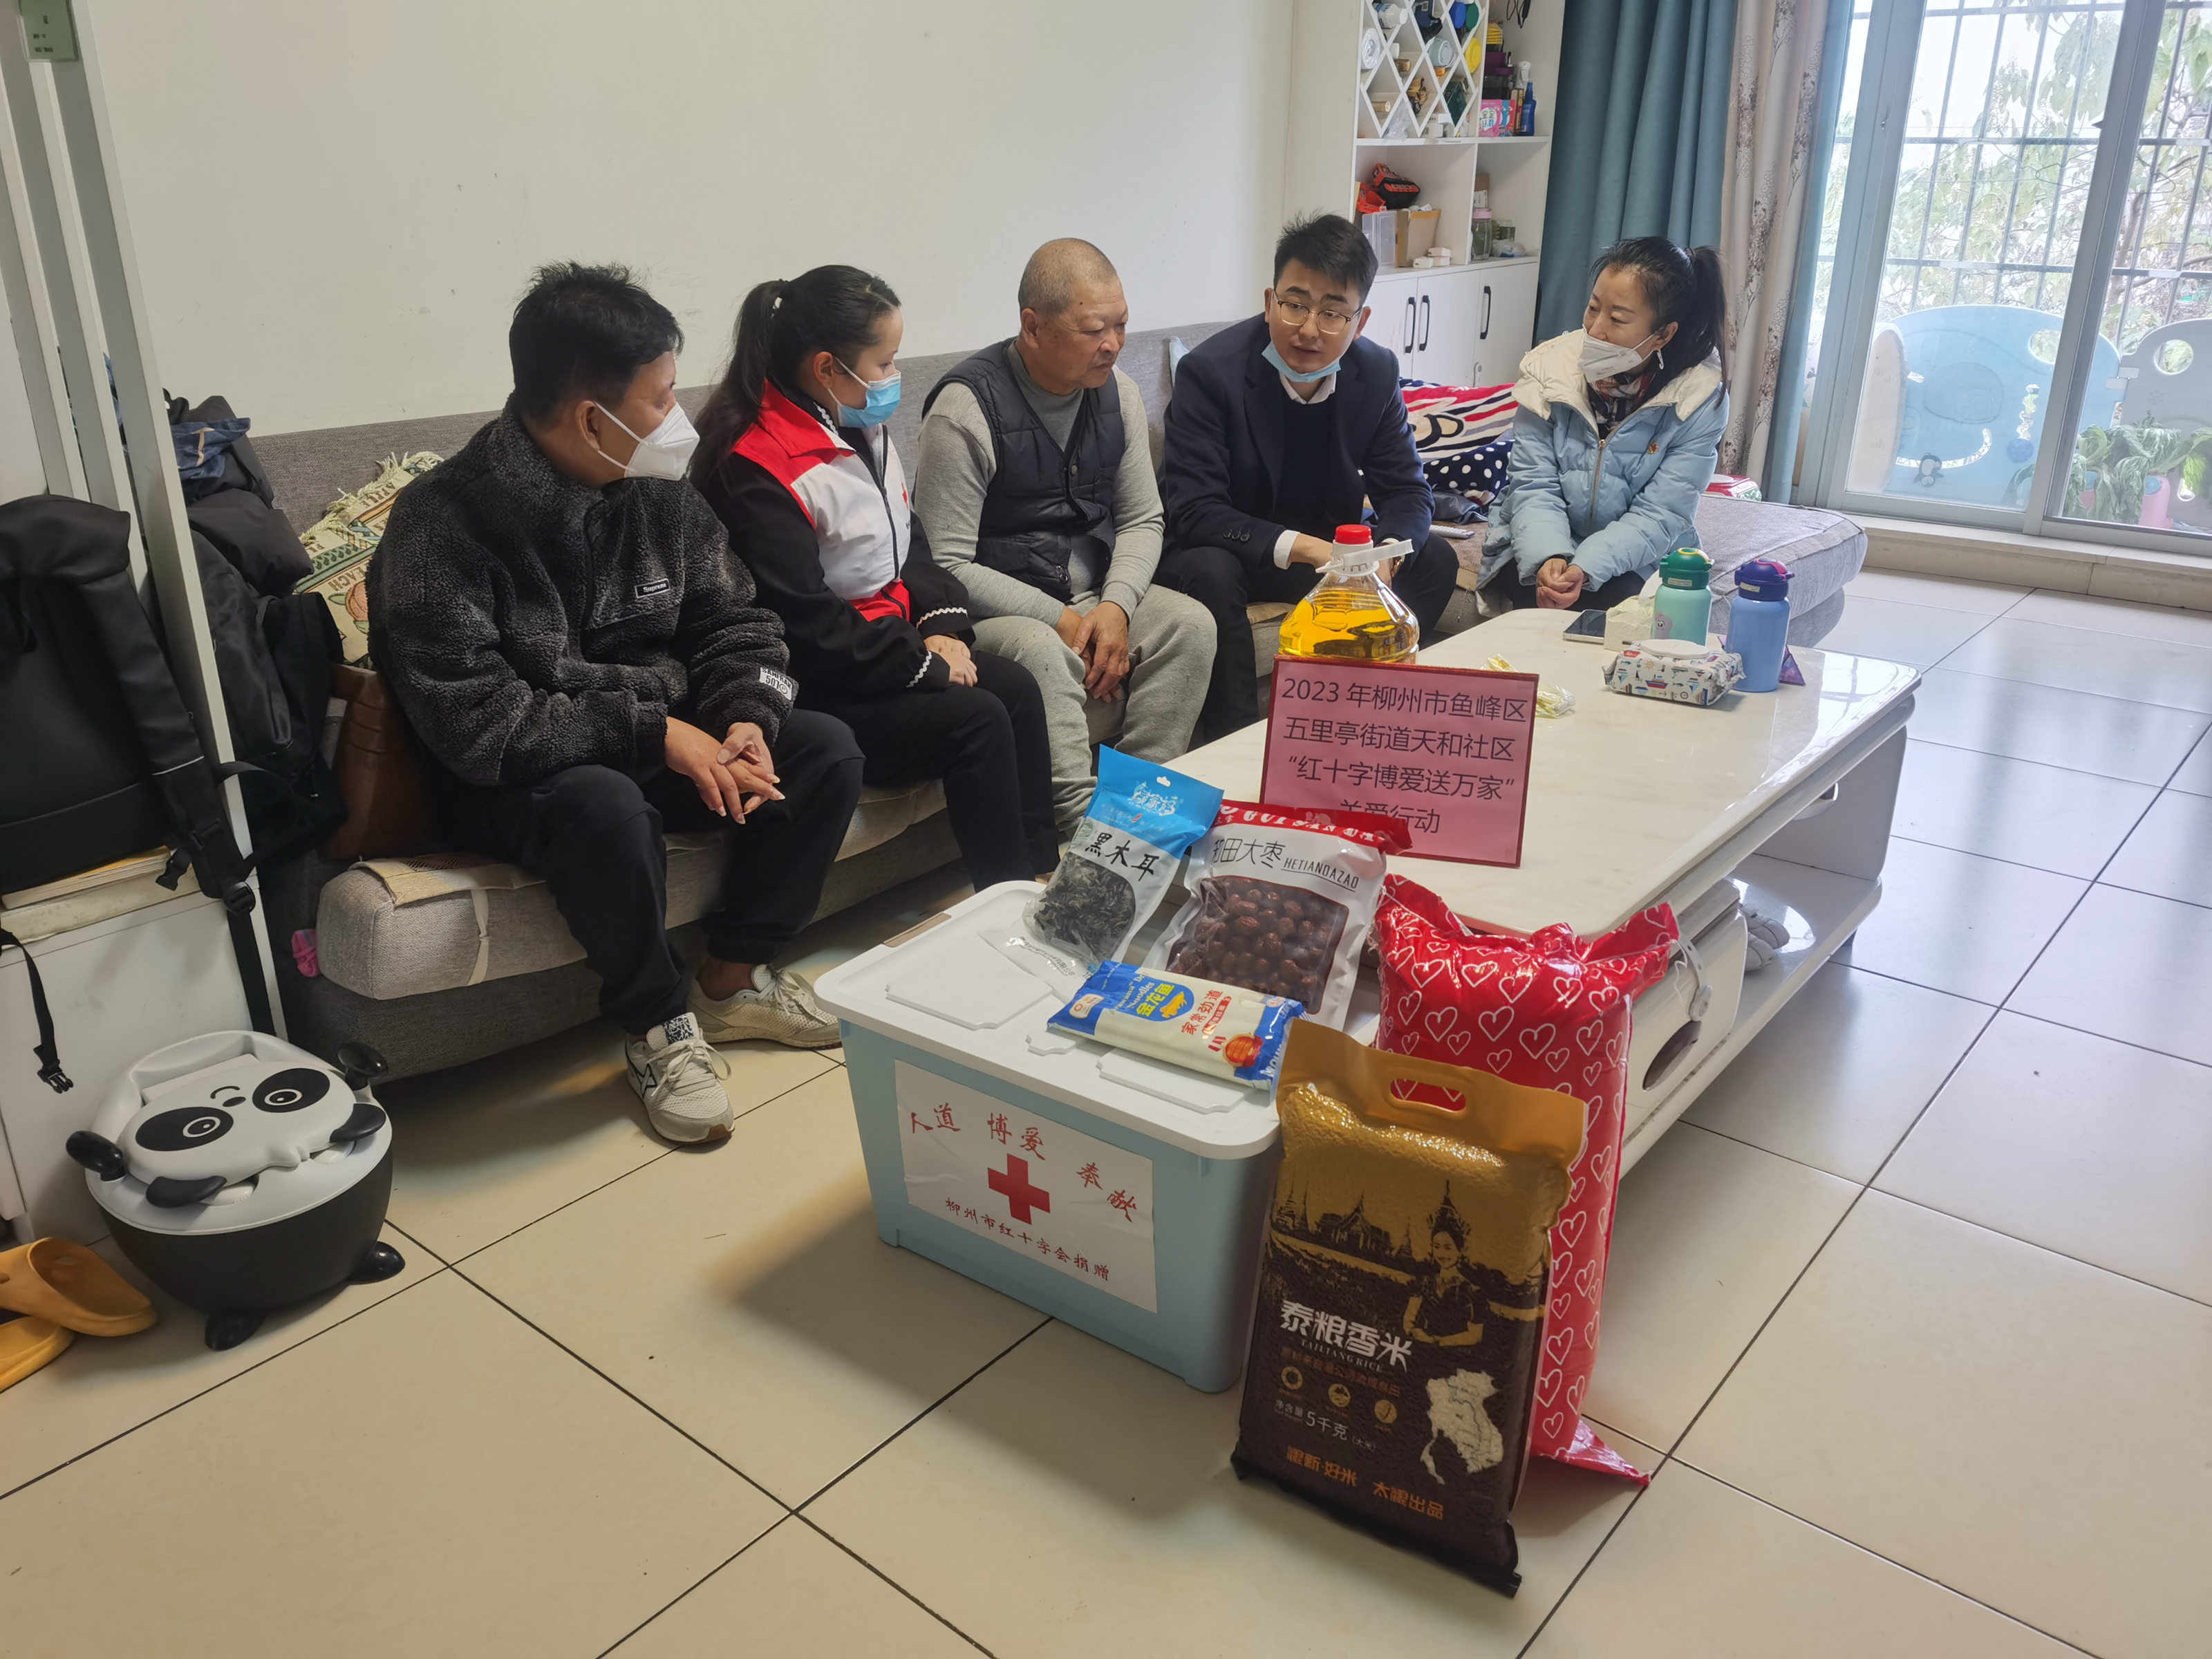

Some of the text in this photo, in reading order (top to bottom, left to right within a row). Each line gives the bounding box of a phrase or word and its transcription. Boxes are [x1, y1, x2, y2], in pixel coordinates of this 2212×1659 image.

[359, 482, 396, 508] APPLE
[328, 565, 368, 592] EACH
[765, 675, 780, 690] 501
[1281, 677, 1529, 724] 2023 年柳州市鱼峰区
[1283, 716, 1517, 762] 五里亭街道天和社区
[1085, 832, 1160, 882] 黑木耳
[1283, 857, 1360, 890] HETIANDAZAO
[1125, 981, 1156, 1009] Noodles
[1136, 982, 1176, 1018] 金龙鱼
[1181, 989, 1224, 1036] 家常劲道
[910, 1102, 1137, 1223] 人道 博爱 奉献
[944, 1197, 1110, 1282] 柳州市红十字会捐赠
[1280, 1299, 1414, 1374] 泰粮香米
